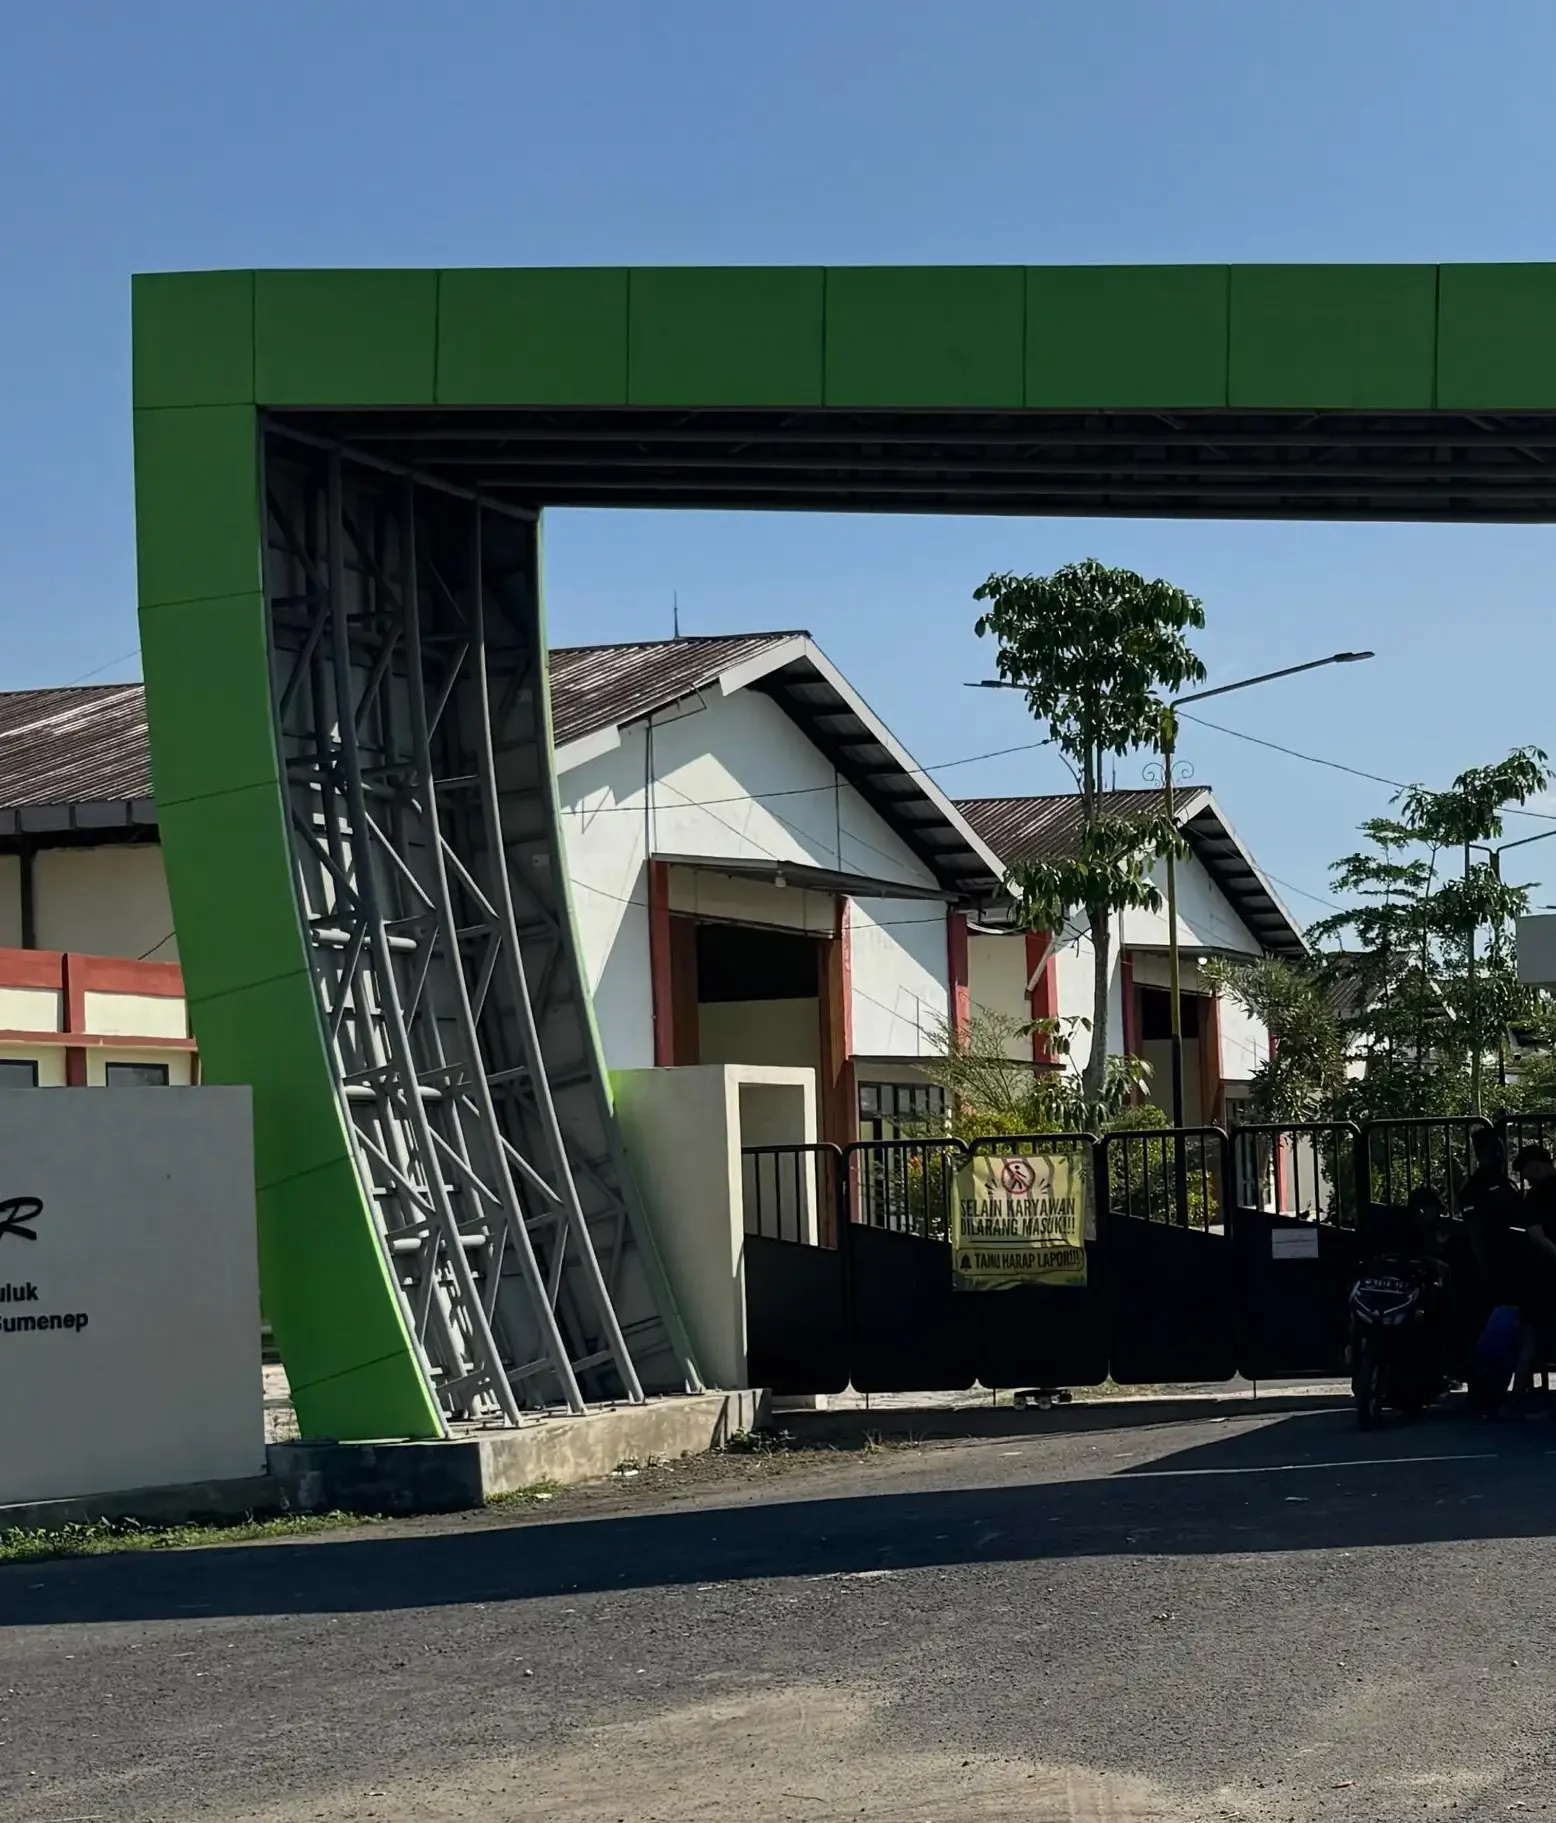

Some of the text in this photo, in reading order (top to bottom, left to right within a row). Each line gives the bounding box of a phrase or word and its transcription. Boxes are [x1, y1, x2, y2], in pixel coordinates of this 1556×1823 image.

[960, 1198, 1075, 1217] SELAIN KARYAWAN
[960, 1217, 1075, 1236] DILARANG MASUK!!!
[1002, 1253, 1035, 1269] HARAP
[0, 1313, 89, 1333] umenep
